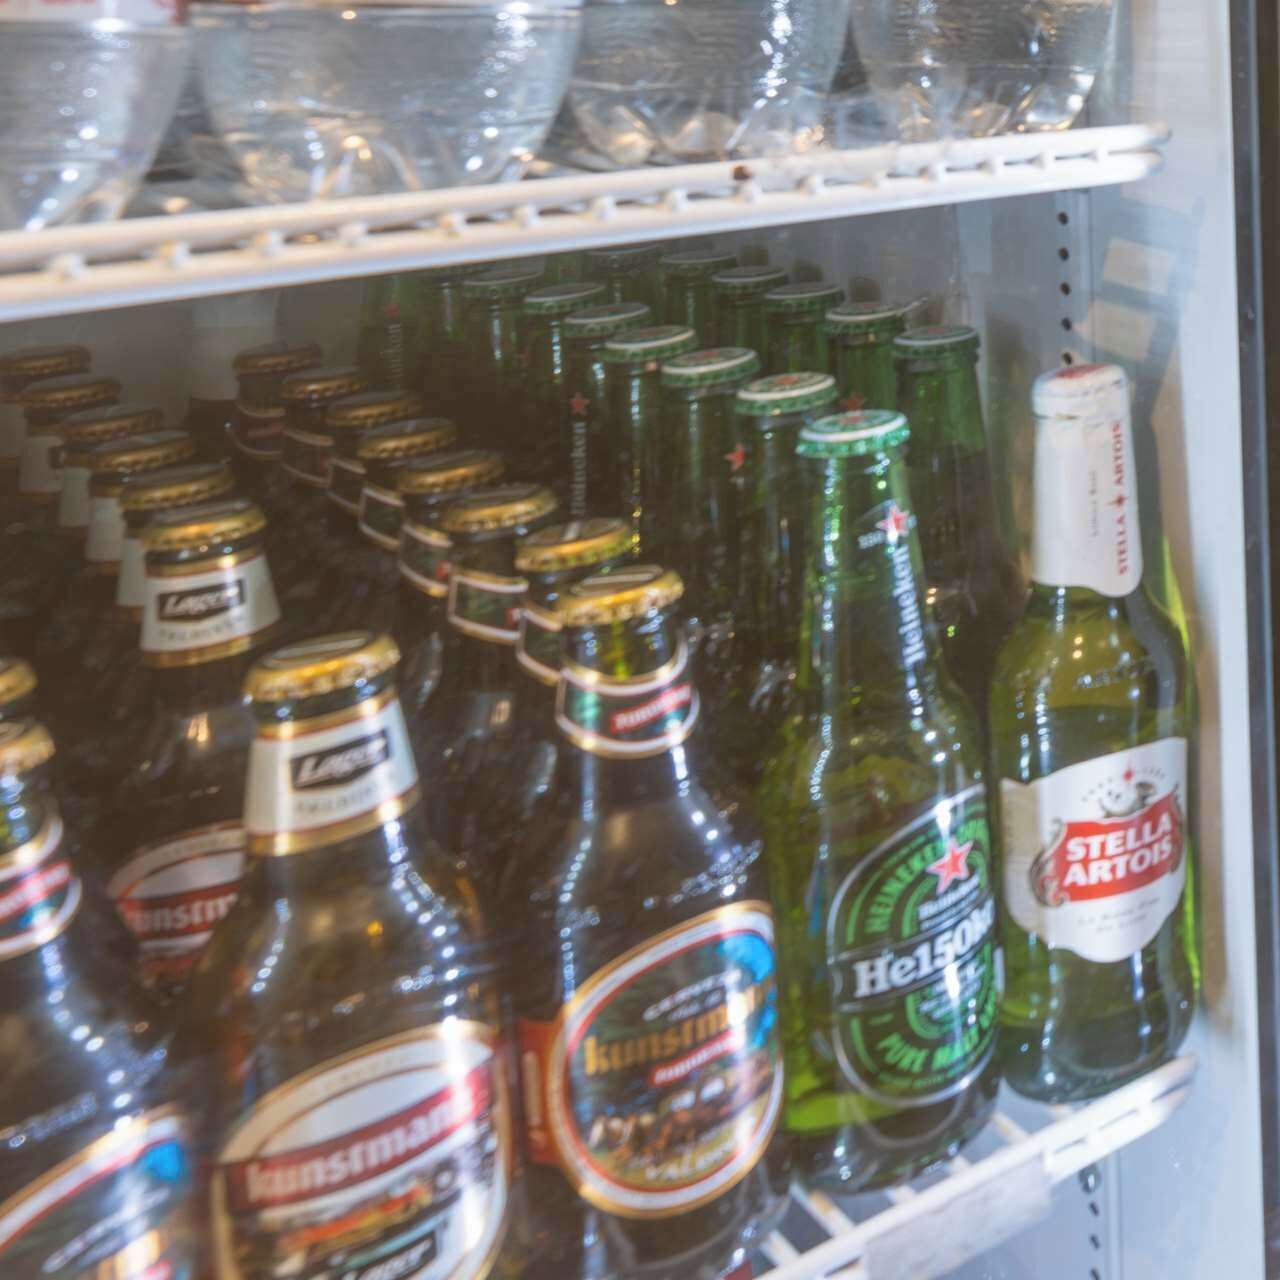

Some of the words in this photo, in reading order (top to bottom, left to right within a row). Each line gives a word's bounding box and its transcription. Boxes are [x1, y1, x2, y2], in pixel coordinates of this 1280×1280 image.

[1110, 422, 1124, 485] ARTOIS
[1116, 515, 1129, 575] STELLA
[1062, 835, 1172, 887] ARTOIS
[1065, 812, 1172, 862] STELLA
